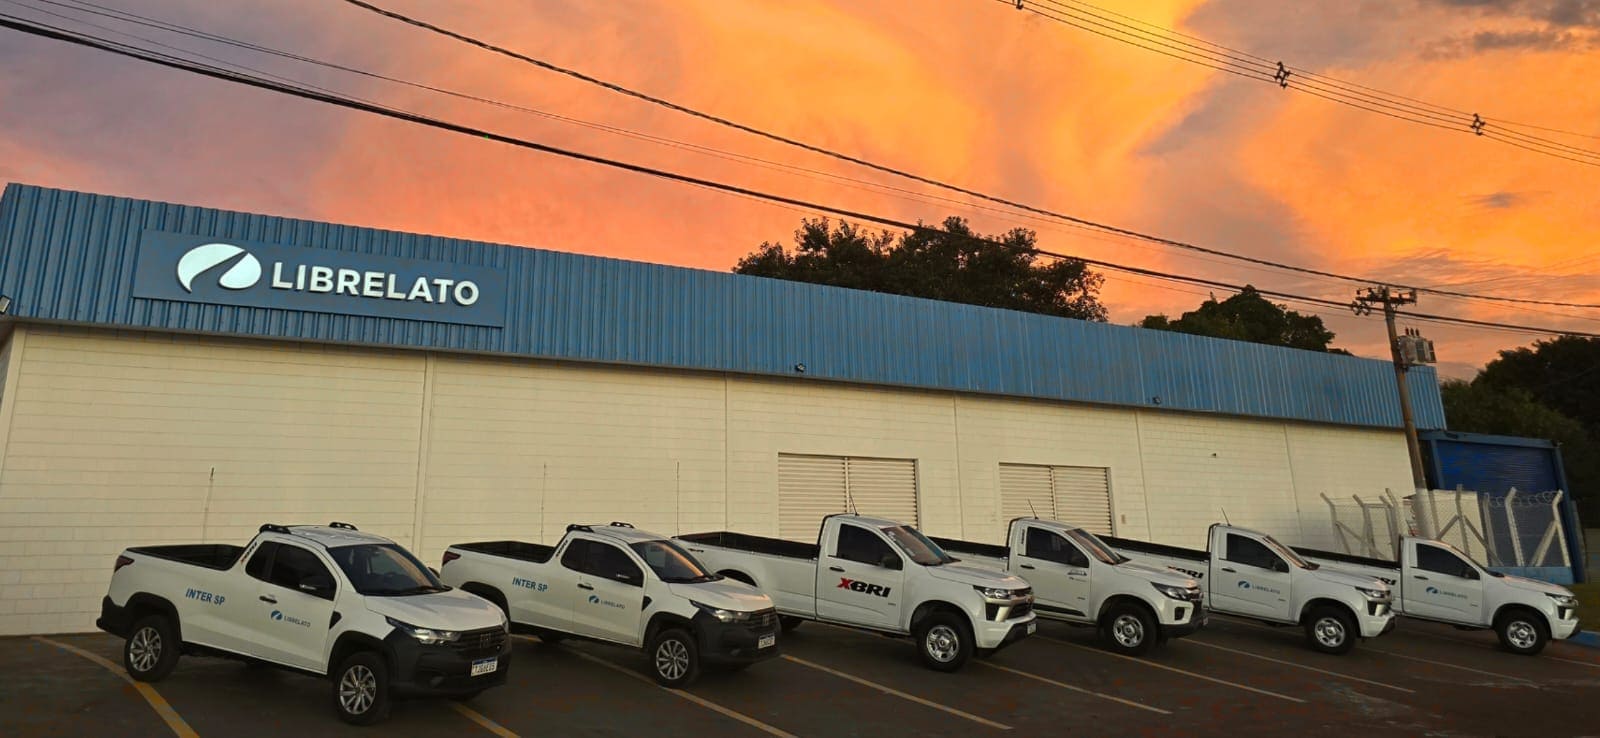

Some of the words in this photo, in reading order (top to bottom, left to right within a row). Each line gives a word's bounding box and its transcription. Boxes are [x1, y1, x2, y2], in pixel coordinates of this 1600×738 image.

[271, 261, 479, 306] LIBRELATO
[512, 576, 536, 591] INTER
[537, 582, 548, 592] SP
[836, 577, 892, 598] XBRI
[185, 587, 212, 604] INTER
[213, 593, 226, 606] SP
[284, 615, 311, 628] LIBRELATO
